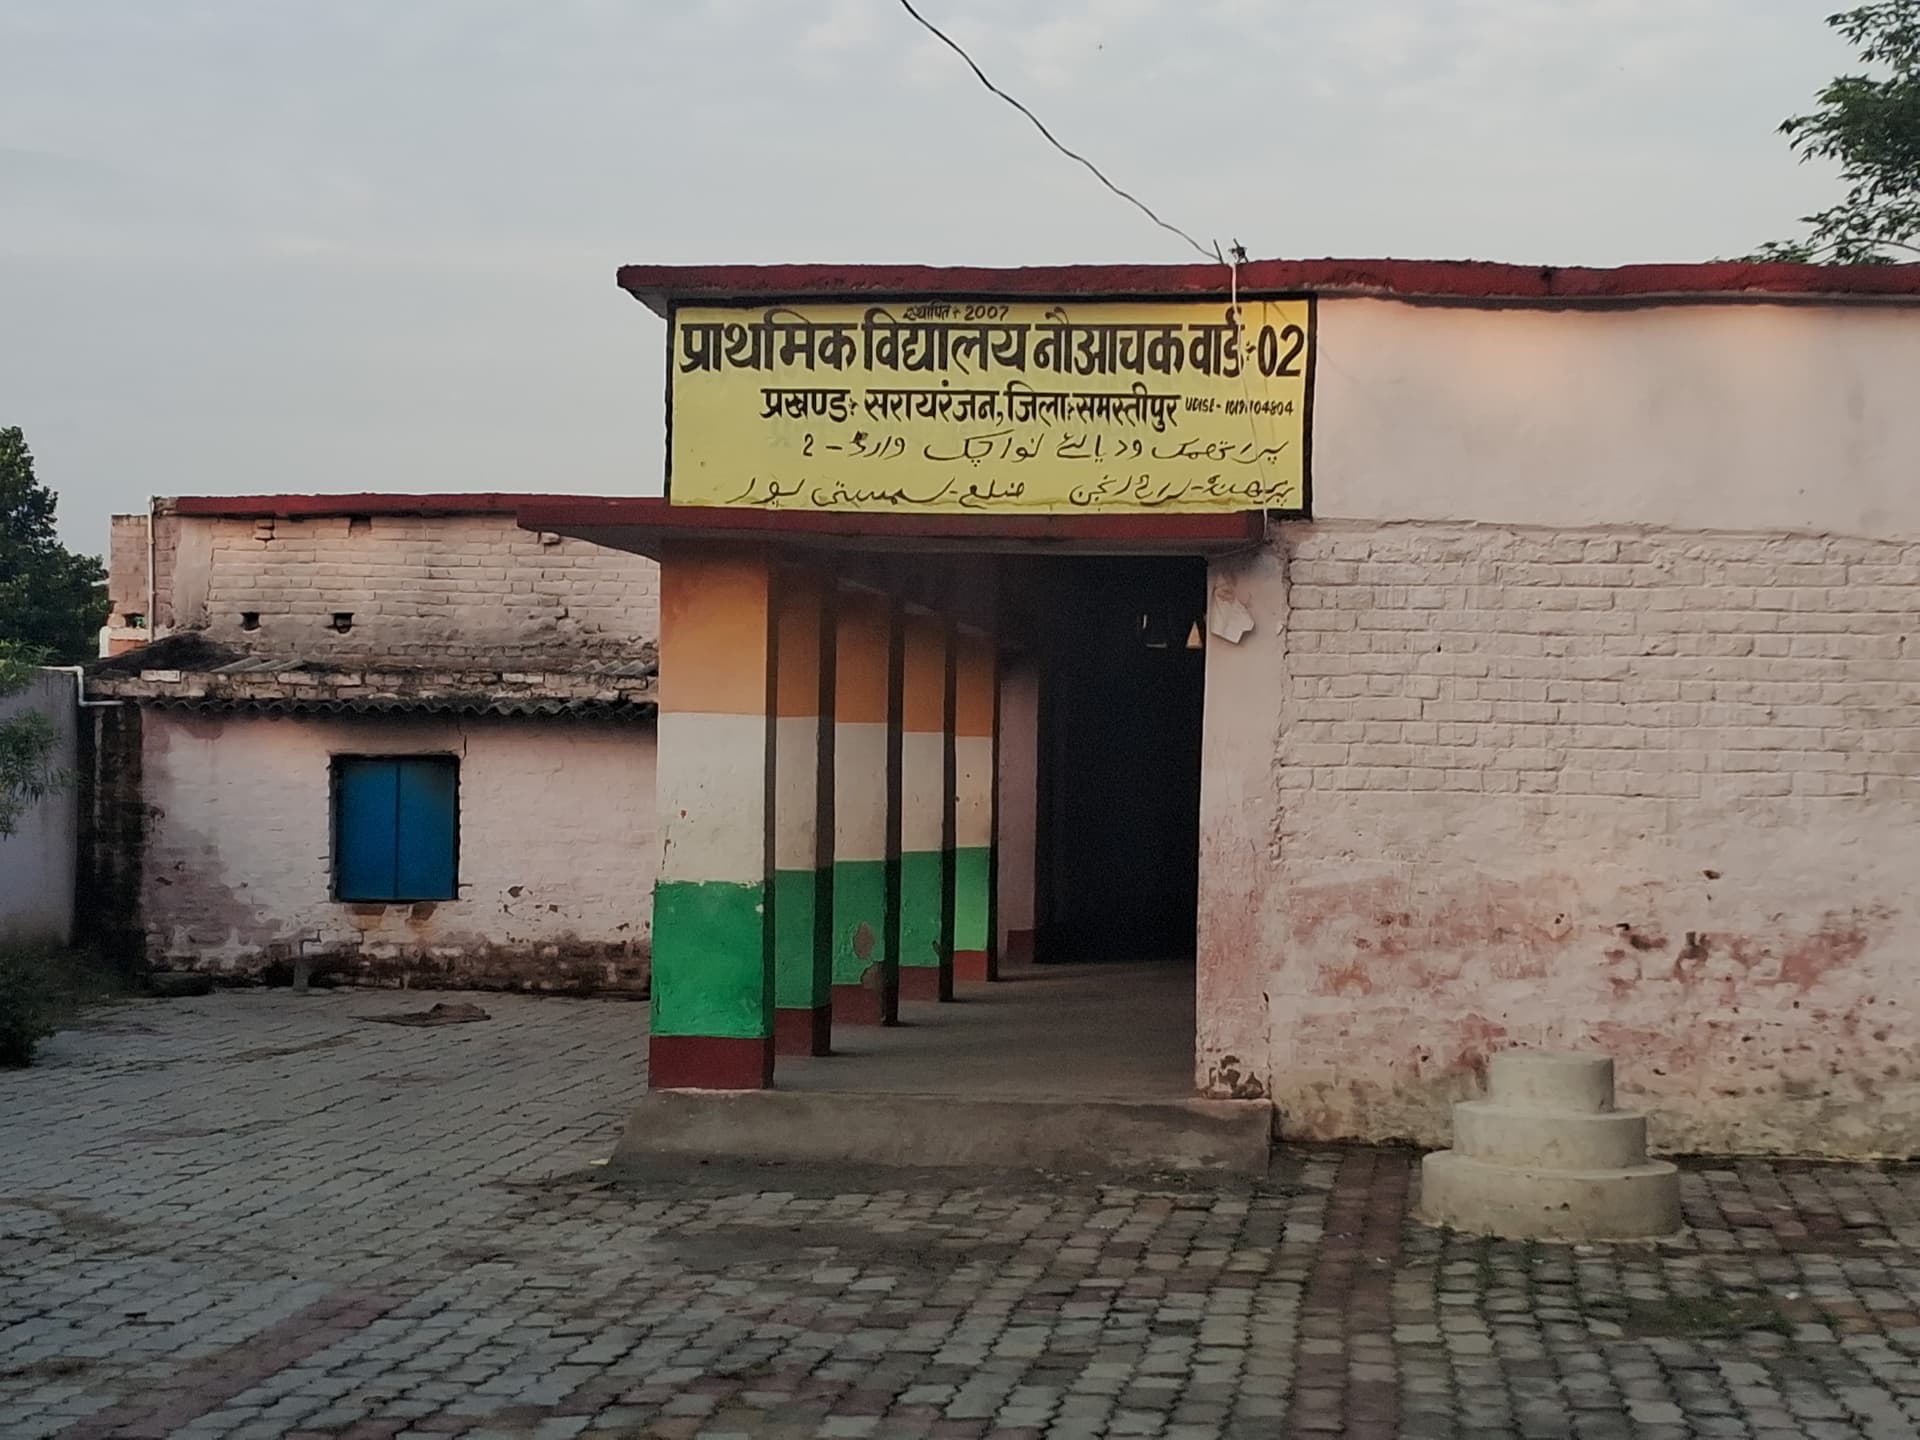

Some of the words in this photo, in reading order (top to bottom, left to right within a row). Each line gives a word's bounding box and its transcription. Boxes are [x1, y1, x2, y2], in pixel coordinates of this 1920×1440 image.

[964, 305, 1009, 321] 2007
[679, 308, 857, 373] प्राथमिक
[861, 307, 1031, 375] विद्यालय
